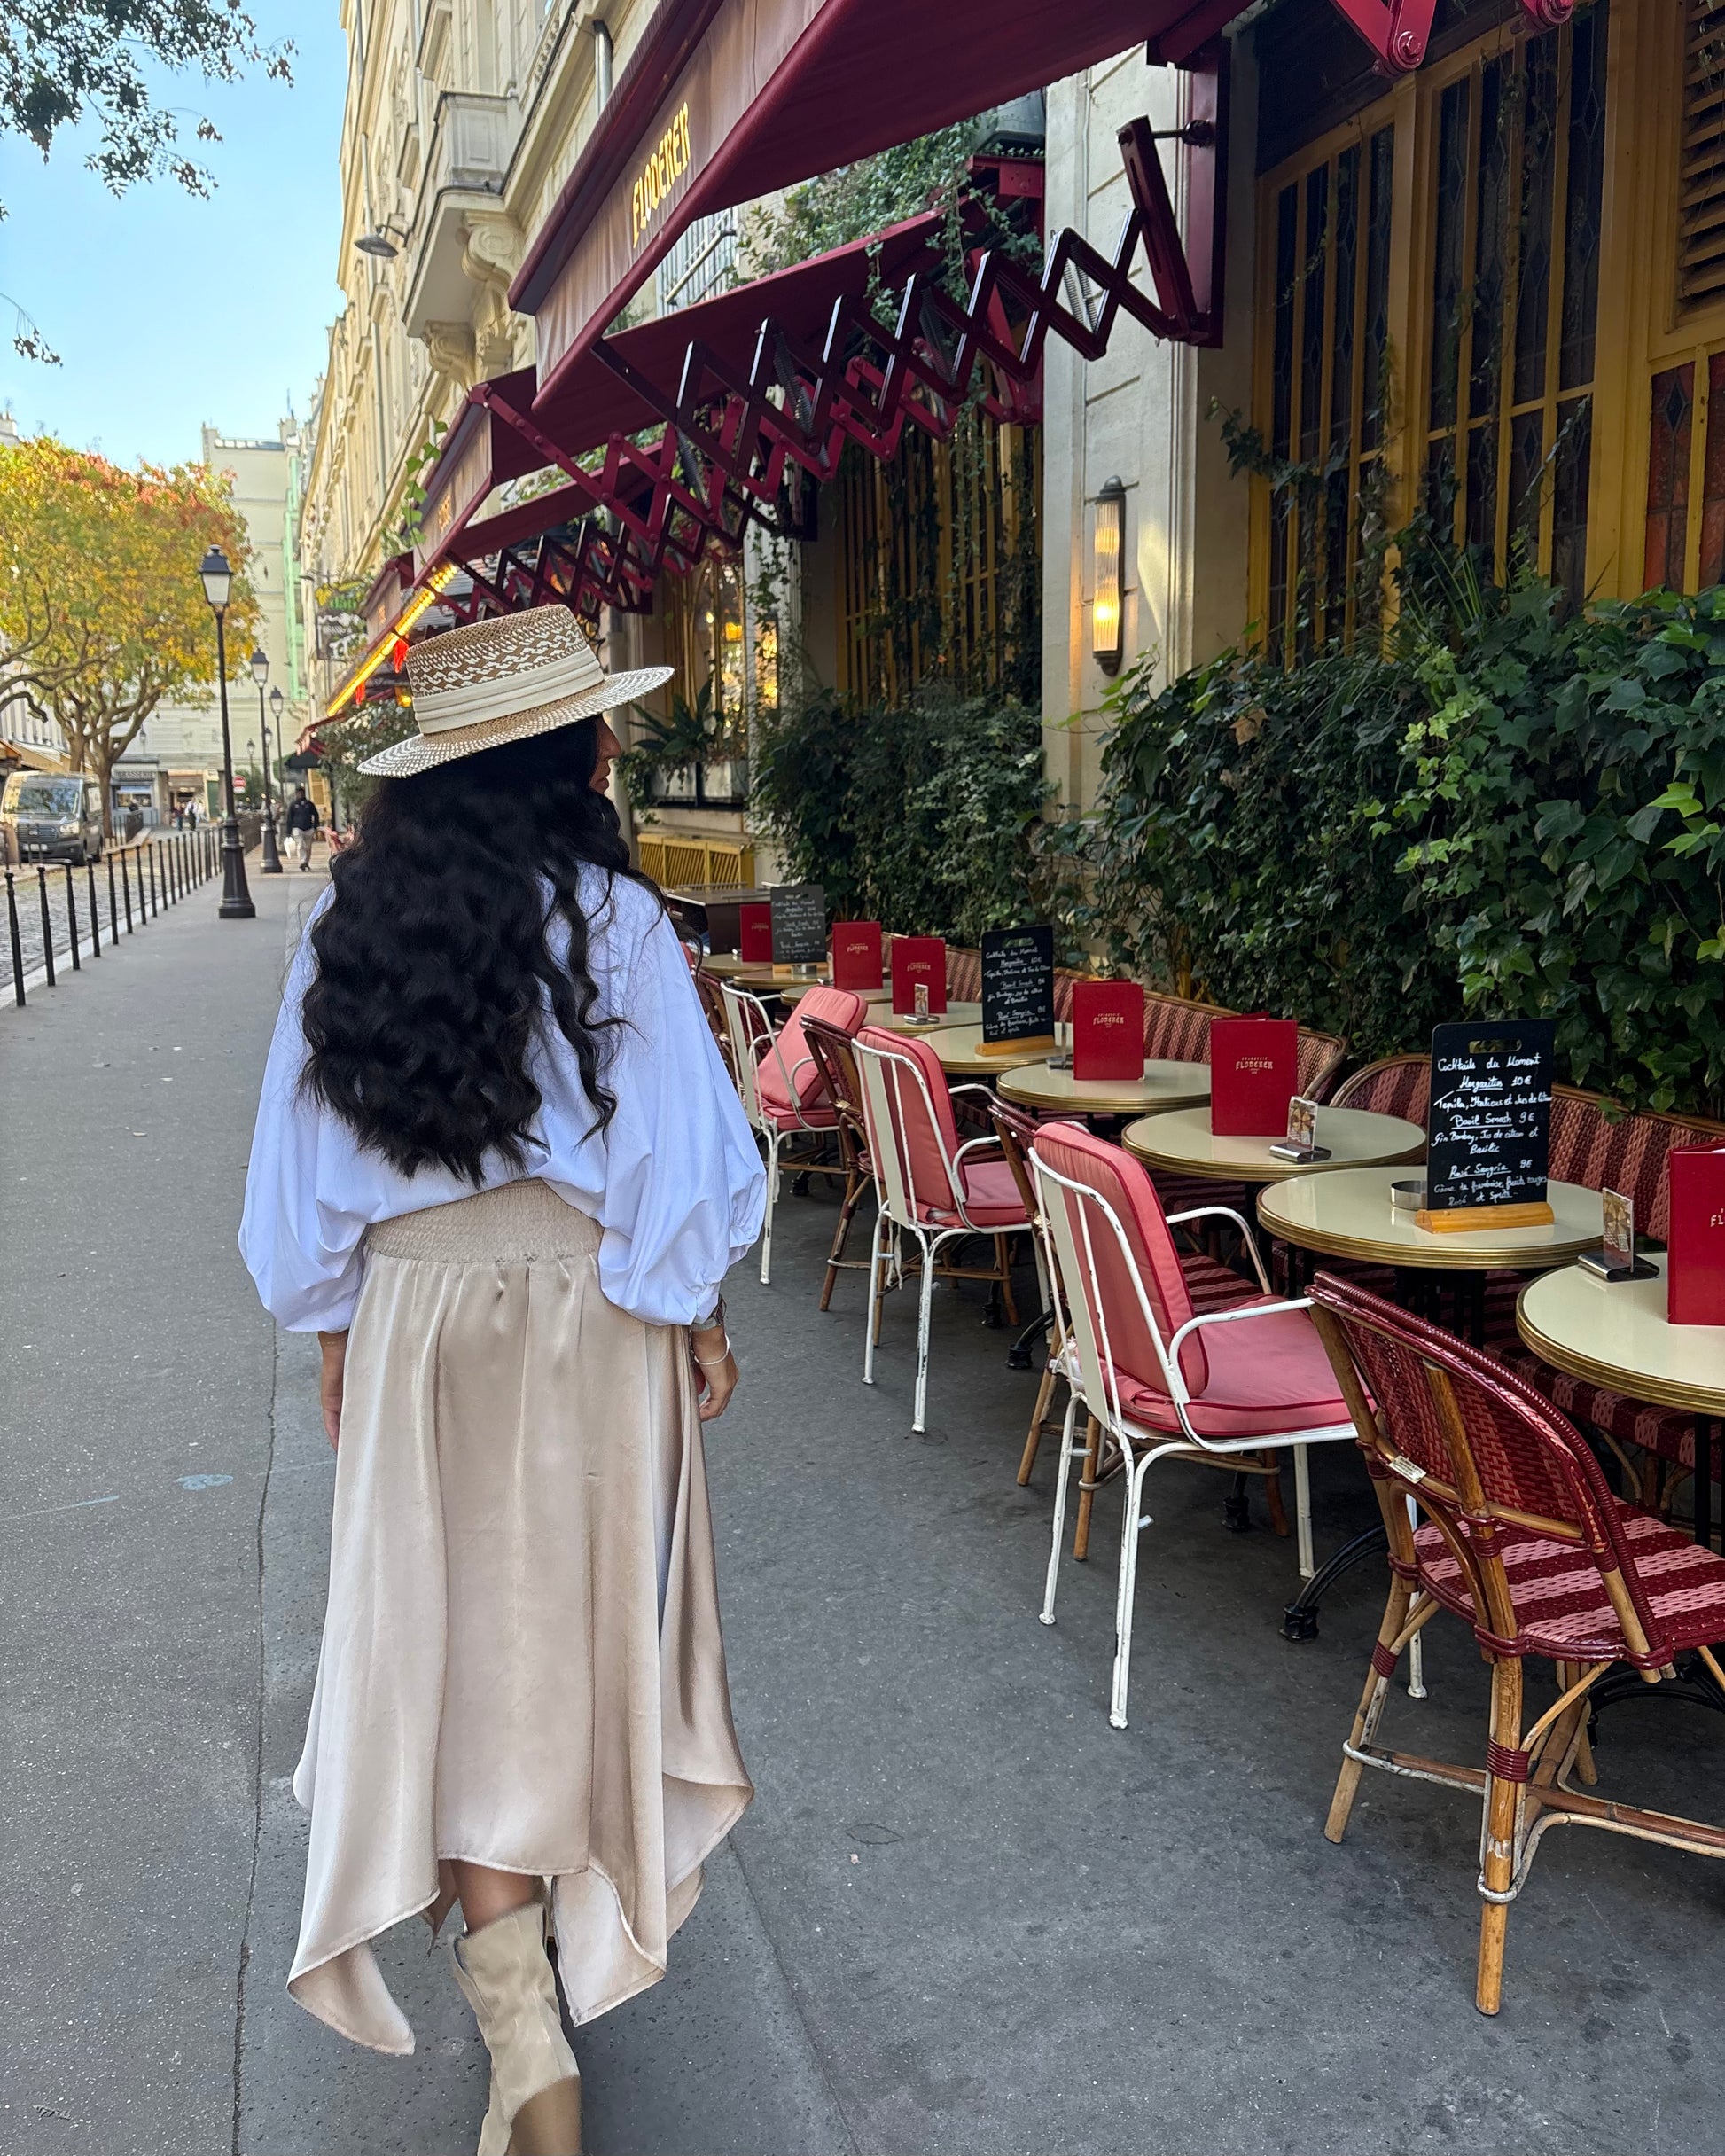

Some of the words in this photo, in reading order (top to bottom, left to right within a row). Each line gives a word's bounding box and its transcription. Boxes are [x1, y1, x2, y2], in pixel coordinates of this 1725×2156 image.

[633, 101, 691, 248] FLODERER
[1437, 1056, 1476, 1072] Cocktails
[1486, 1056, 1501, 1069] du
[1506, 1052, 1542, 1067] Moment
[1510, 1075, 1532, 1087] 10€
[1503, 1093, 1513, 1105] et
[1528, 1091, 1538, 1103] de
[1449, 1113, 1480, 1128] Basil
[1485, 1111, 1512, 1123] Smash
[1431, 1131, 1448, 1147] Gin
[1493, 1129, 1503, 1139] de
[1528, 1126, 1539, 1137] et
[1469, 1142, 1500, 1155] Basilic
[1519, 1160, 1534, 1169] 9€
